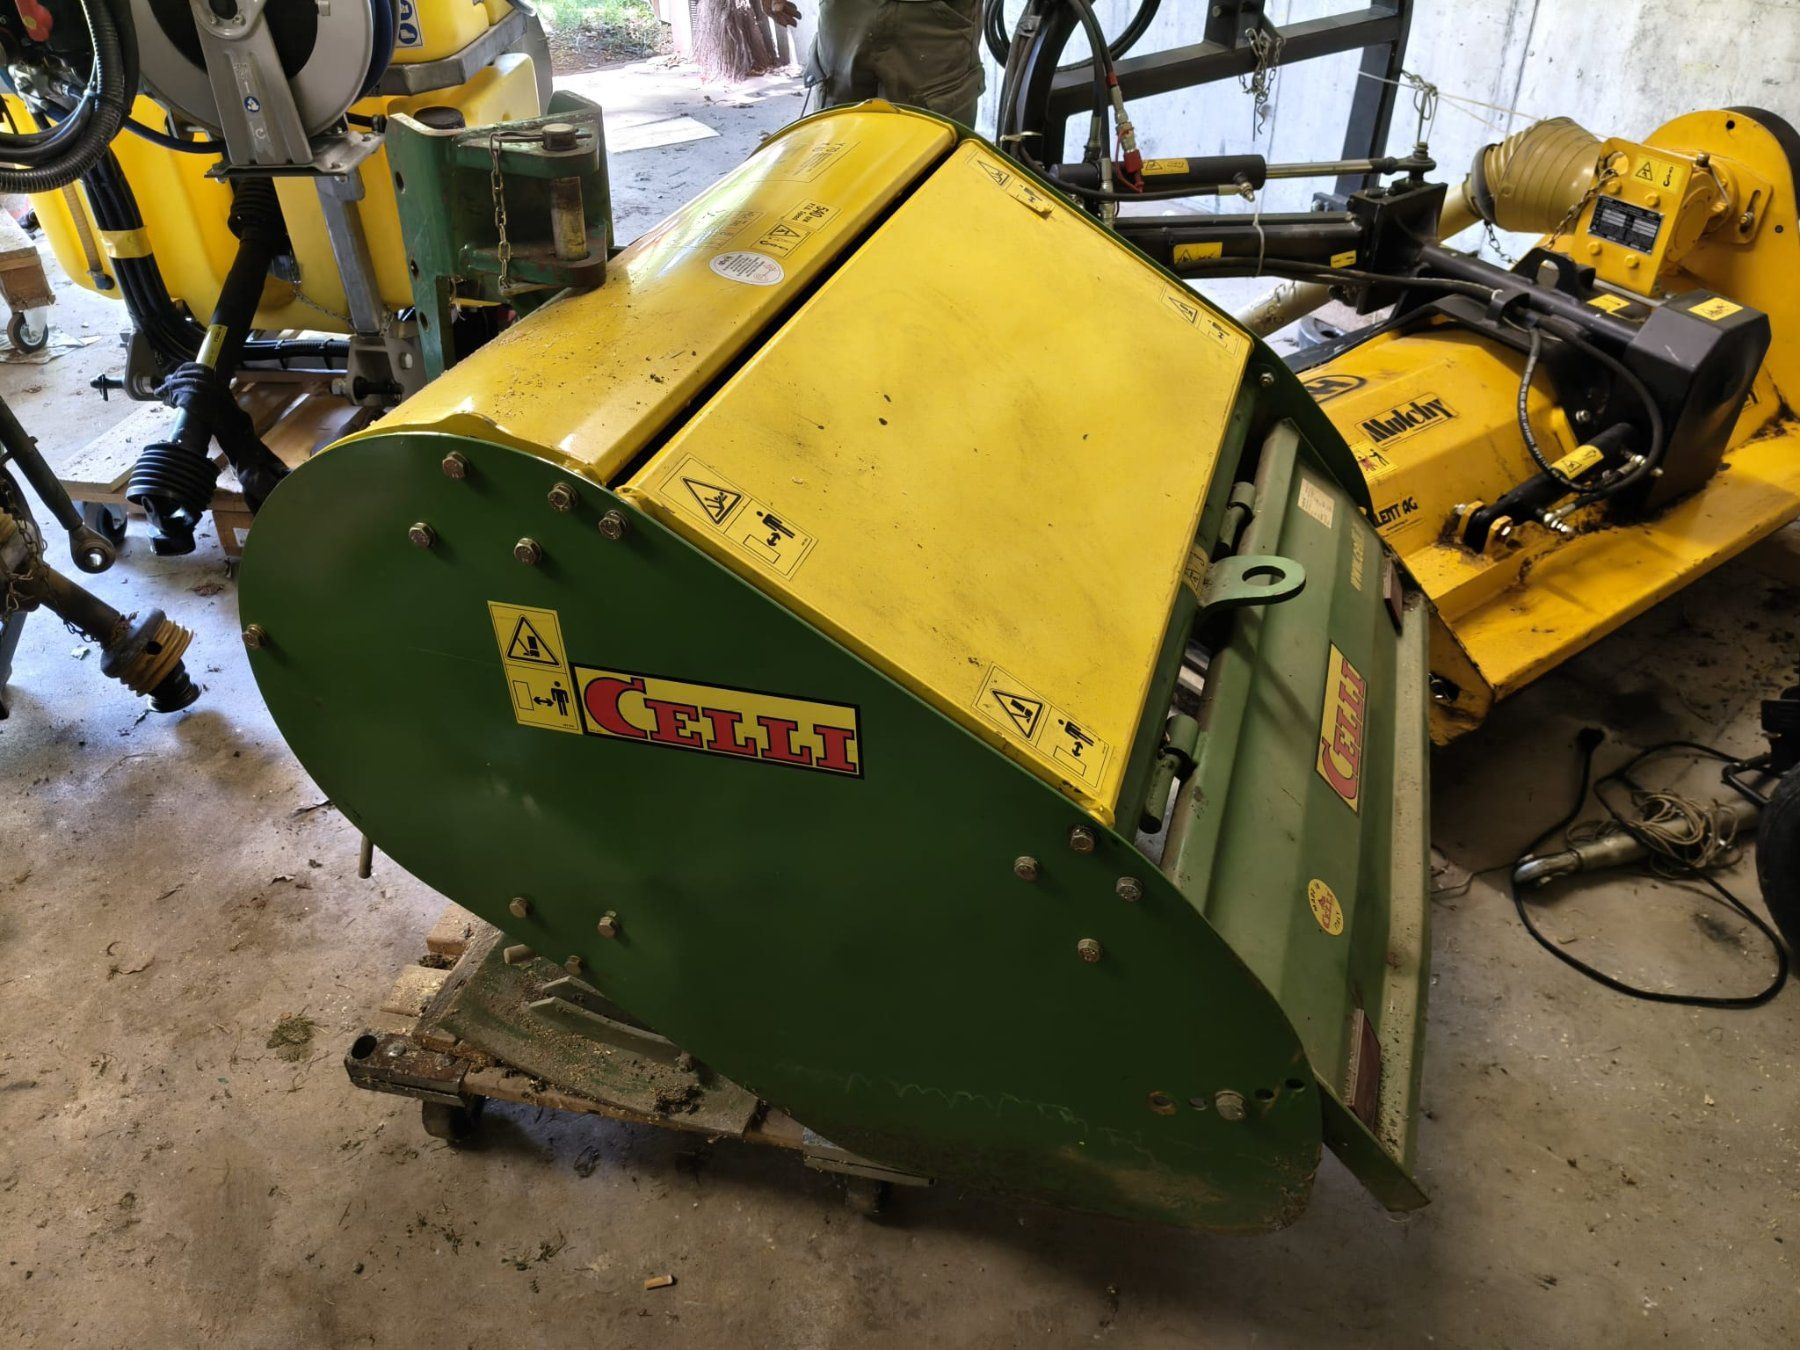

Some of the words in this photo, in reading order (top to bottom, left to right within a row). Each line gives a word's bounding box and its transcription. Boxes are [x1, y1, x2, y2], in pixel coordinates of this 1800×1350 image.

[809, 205, 829, 218] 540
[1361, 399, 1453, 442] Mulchy
[584, 676, 858, 773] CELLI
[1321, 657, 1366, 800] CELLI
